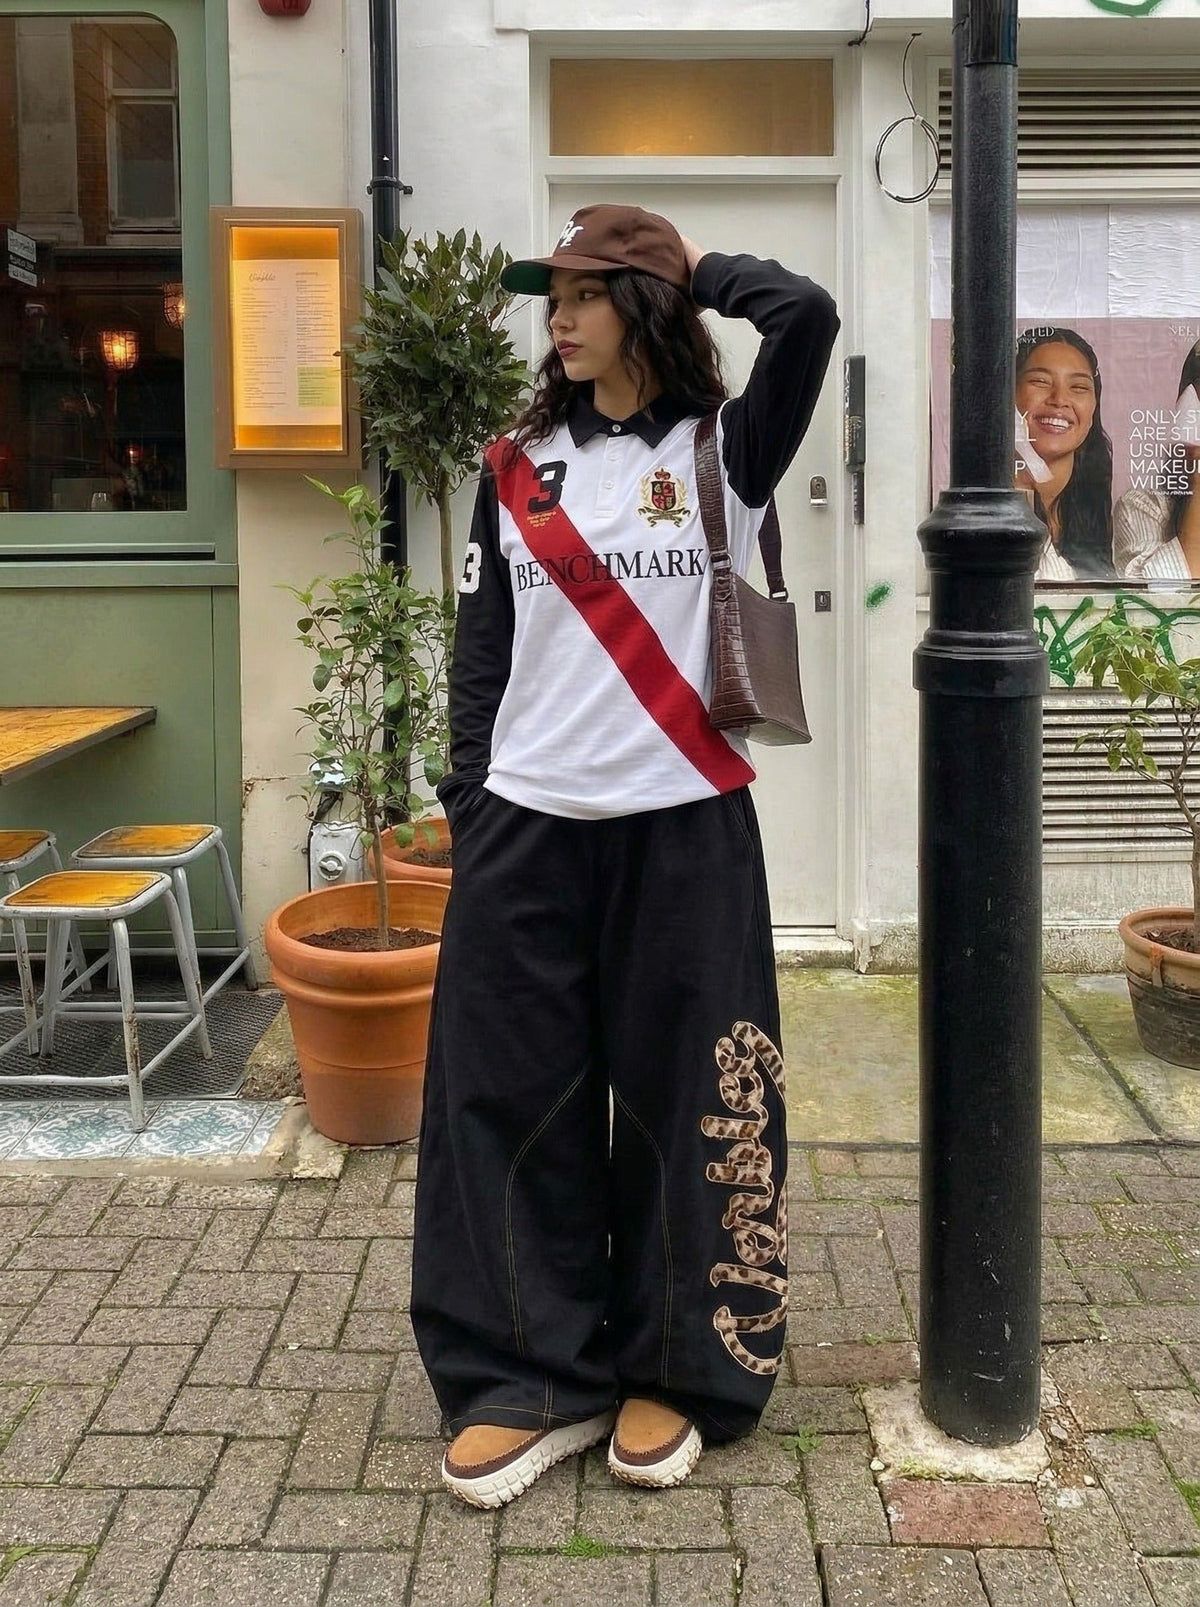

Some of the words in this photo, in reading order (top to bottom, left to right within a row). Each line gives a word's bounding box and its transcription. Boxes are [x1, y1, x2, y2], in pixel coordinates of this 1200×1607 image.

[1130, 409, 1181, 424] ONLY
[1185, 409, 1200, 424] S
[1129, 426, 1167, 441] ARE
[1130, 443, 1186, 458] USING
[527, 460, 568, 513] 3
[1130, 475, 1189, 490] WIPES
[459, 542, 482, 594] 3
[514, 548, 705, 592] BENCHMARK
